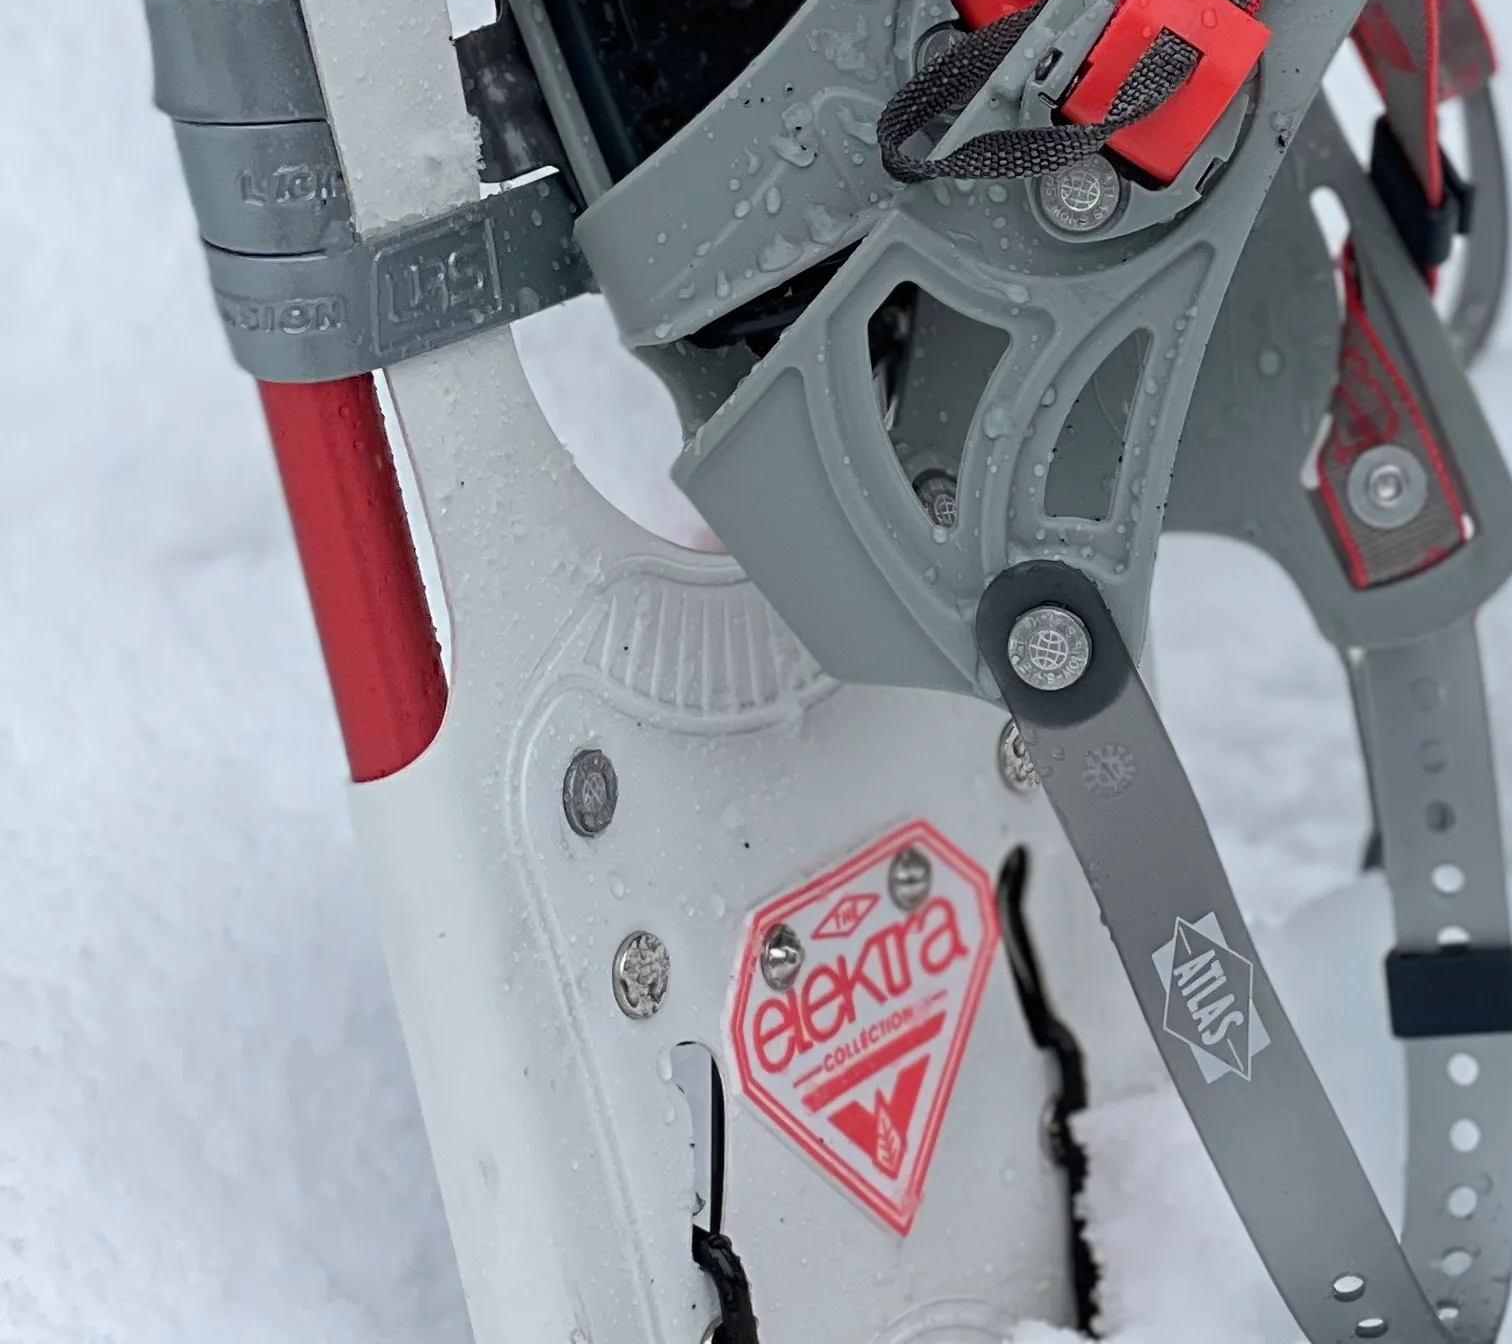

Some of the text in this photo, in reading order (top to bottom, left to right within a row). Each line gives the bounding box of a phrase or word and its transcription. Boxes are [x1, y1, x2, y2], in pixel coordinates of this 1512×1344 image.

[753, 896, 970, 1074] elektra
[1173, 948, 1245, 1046] ATLAS
[822, 1008, 915, 1073] COLLECTION
